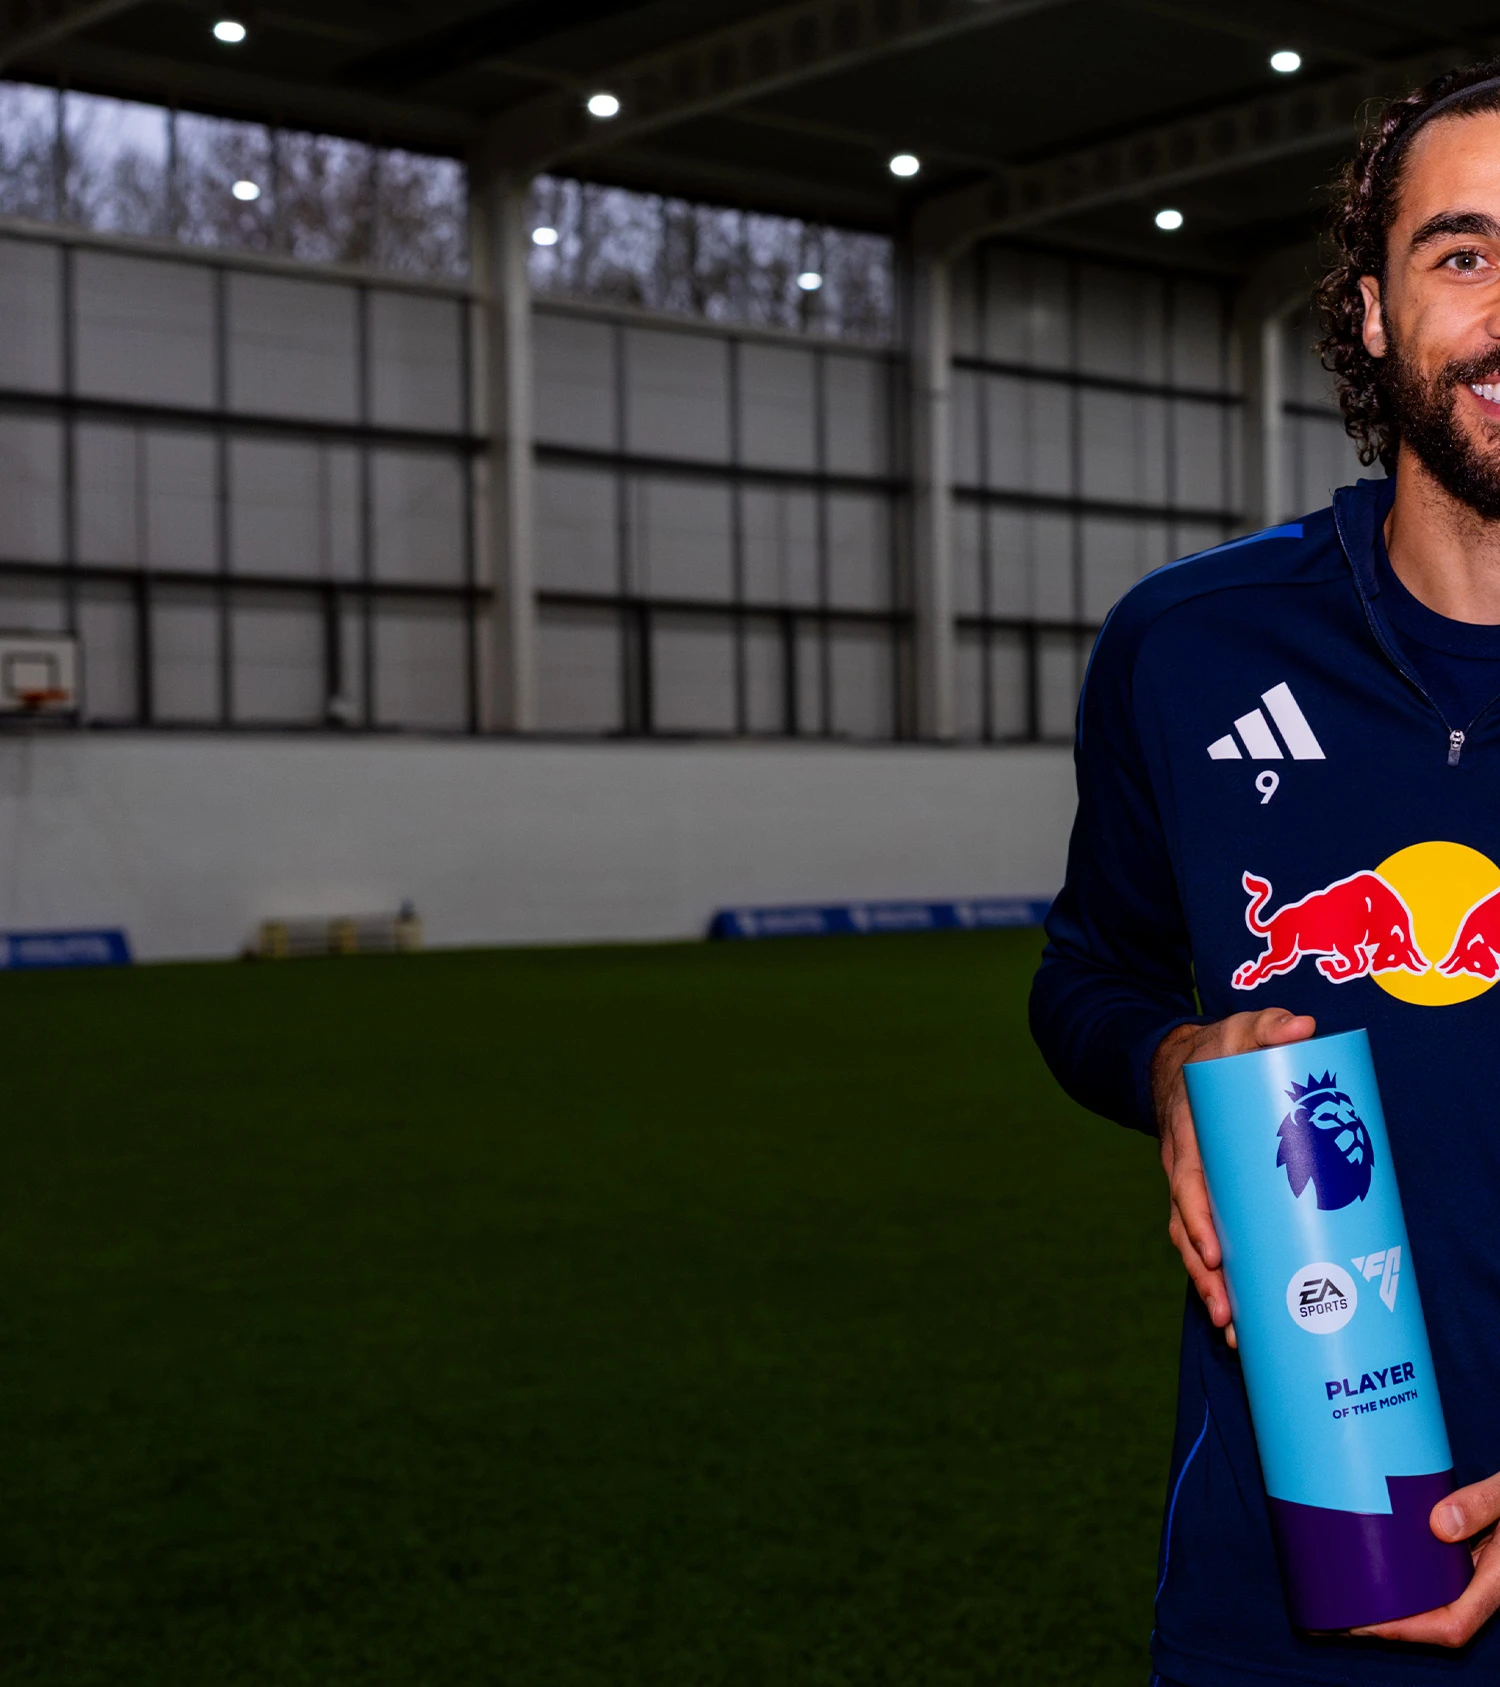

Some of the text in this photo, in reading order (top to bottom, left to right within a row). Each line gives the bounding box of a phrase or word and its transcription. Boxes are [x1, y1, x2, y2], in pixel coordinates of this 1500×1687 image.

[1255, 769, 1280, 804] 9
[1299, 1278, 1345, 1306] EA
[1299, 1298, 1348, 1318] SPORTS
[1325, 1361, 1416, 1401] PLAYER
[1332, 1389, 1418, 1419] OF THE MONTH
